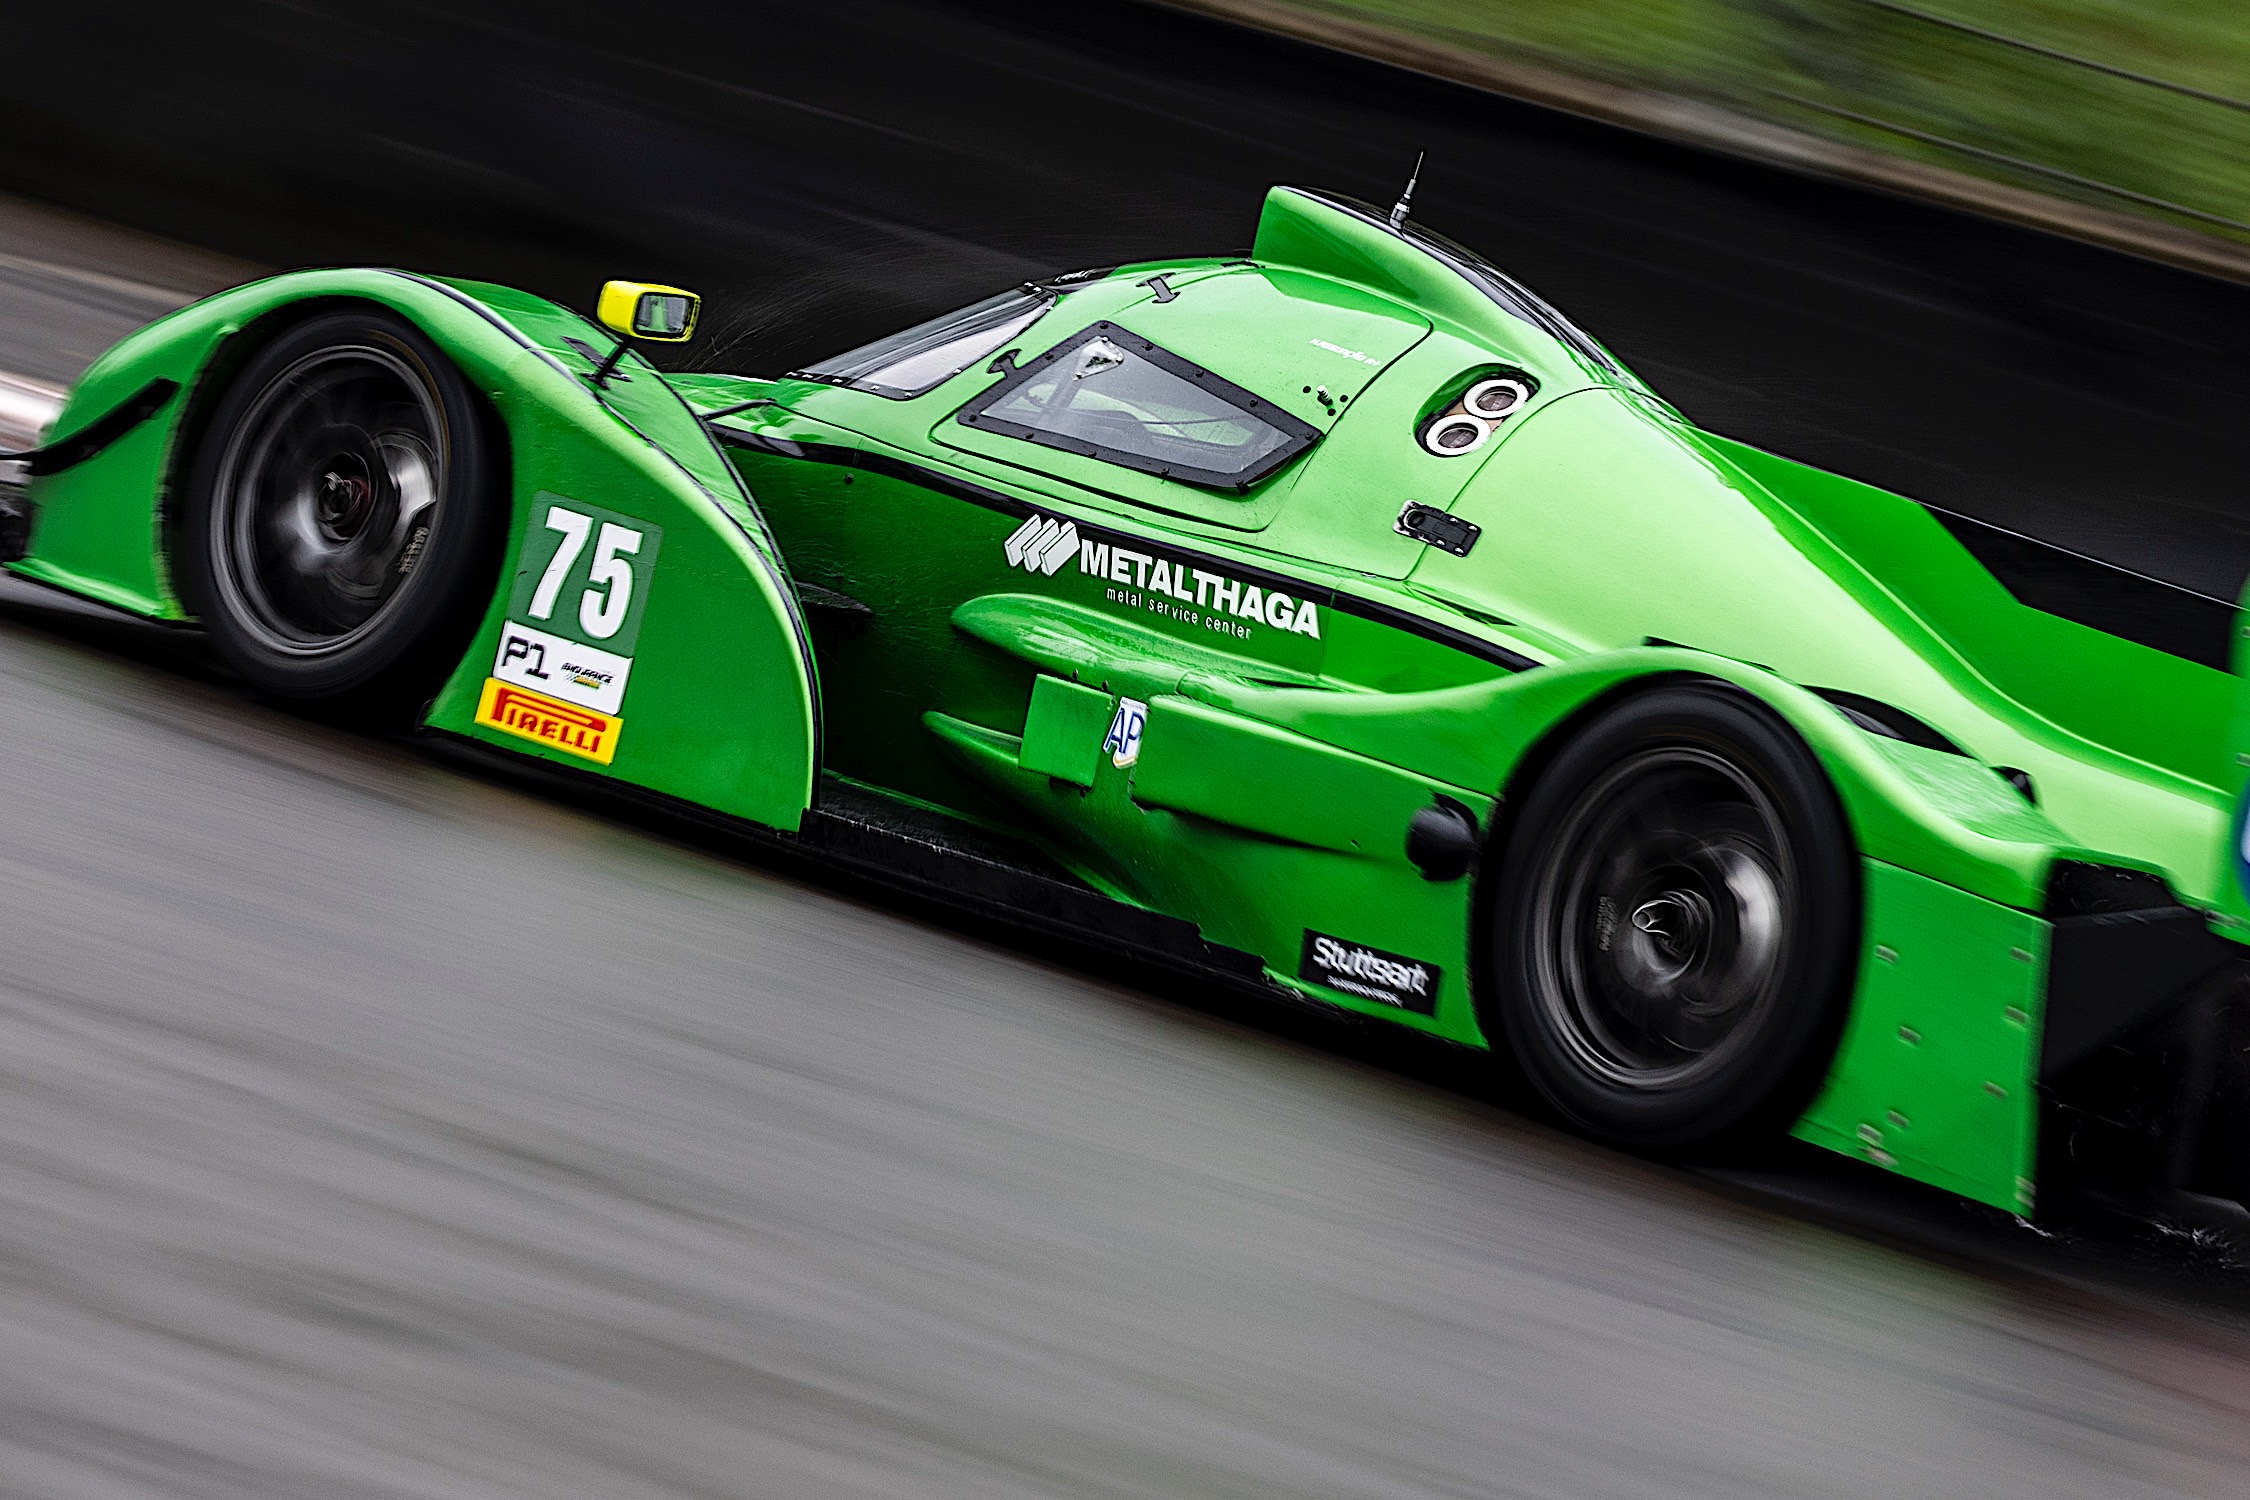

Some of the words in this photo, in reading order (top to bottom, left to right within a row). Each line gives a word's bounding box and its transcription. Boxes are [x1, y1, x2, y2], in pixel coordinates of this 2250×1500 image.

[528, 506, 643, 639] 75
[1080, 538, 1321, 640] METALTHAGA
[1107, 585, 1142, 608] metal
[1148, 598, 1198, 624] service
[1205, 615, 1252, 640] center
[502, 635, 550, 680] P1
[490, 687, 606, 753] PIRELLI
[1105, 707, 1145, 754] AP
